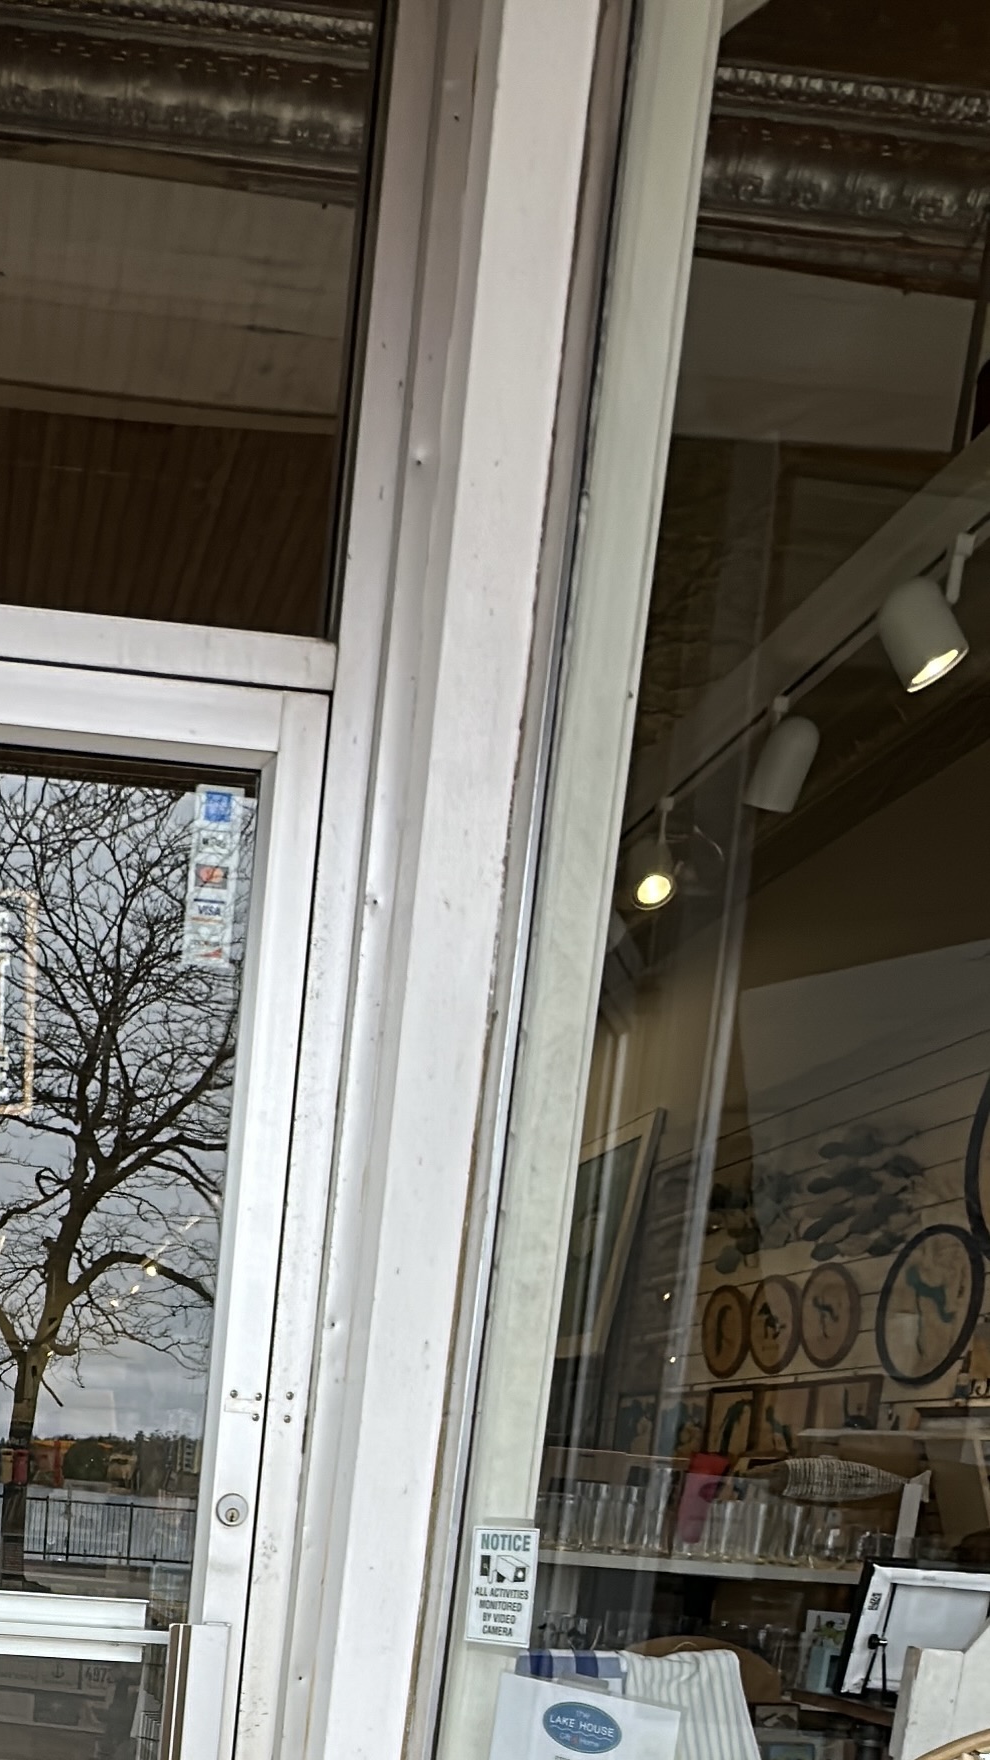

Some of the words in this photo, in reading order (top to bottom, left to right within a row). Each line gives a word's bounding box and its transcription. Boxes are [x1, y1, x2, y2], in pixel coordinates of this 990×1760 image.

[198, 904, 222, 917] VISA
[481, 1533, 532, 1552] NOTICE
[475, 1586, 488, 1597] ALL
[490, 1587, 529, 1600] ACTIVITIES
[479, 1600, 522, 1612] MONITORED
[483, 1612, 492, 1622] BY
[493, 1613, 516, 1625] VIDEO
[482, 1625, 513, 1637] CAMERA
[550, 1714, 575, 1728] LAKE
[579, 1721, 615, 1738] HOUSE
